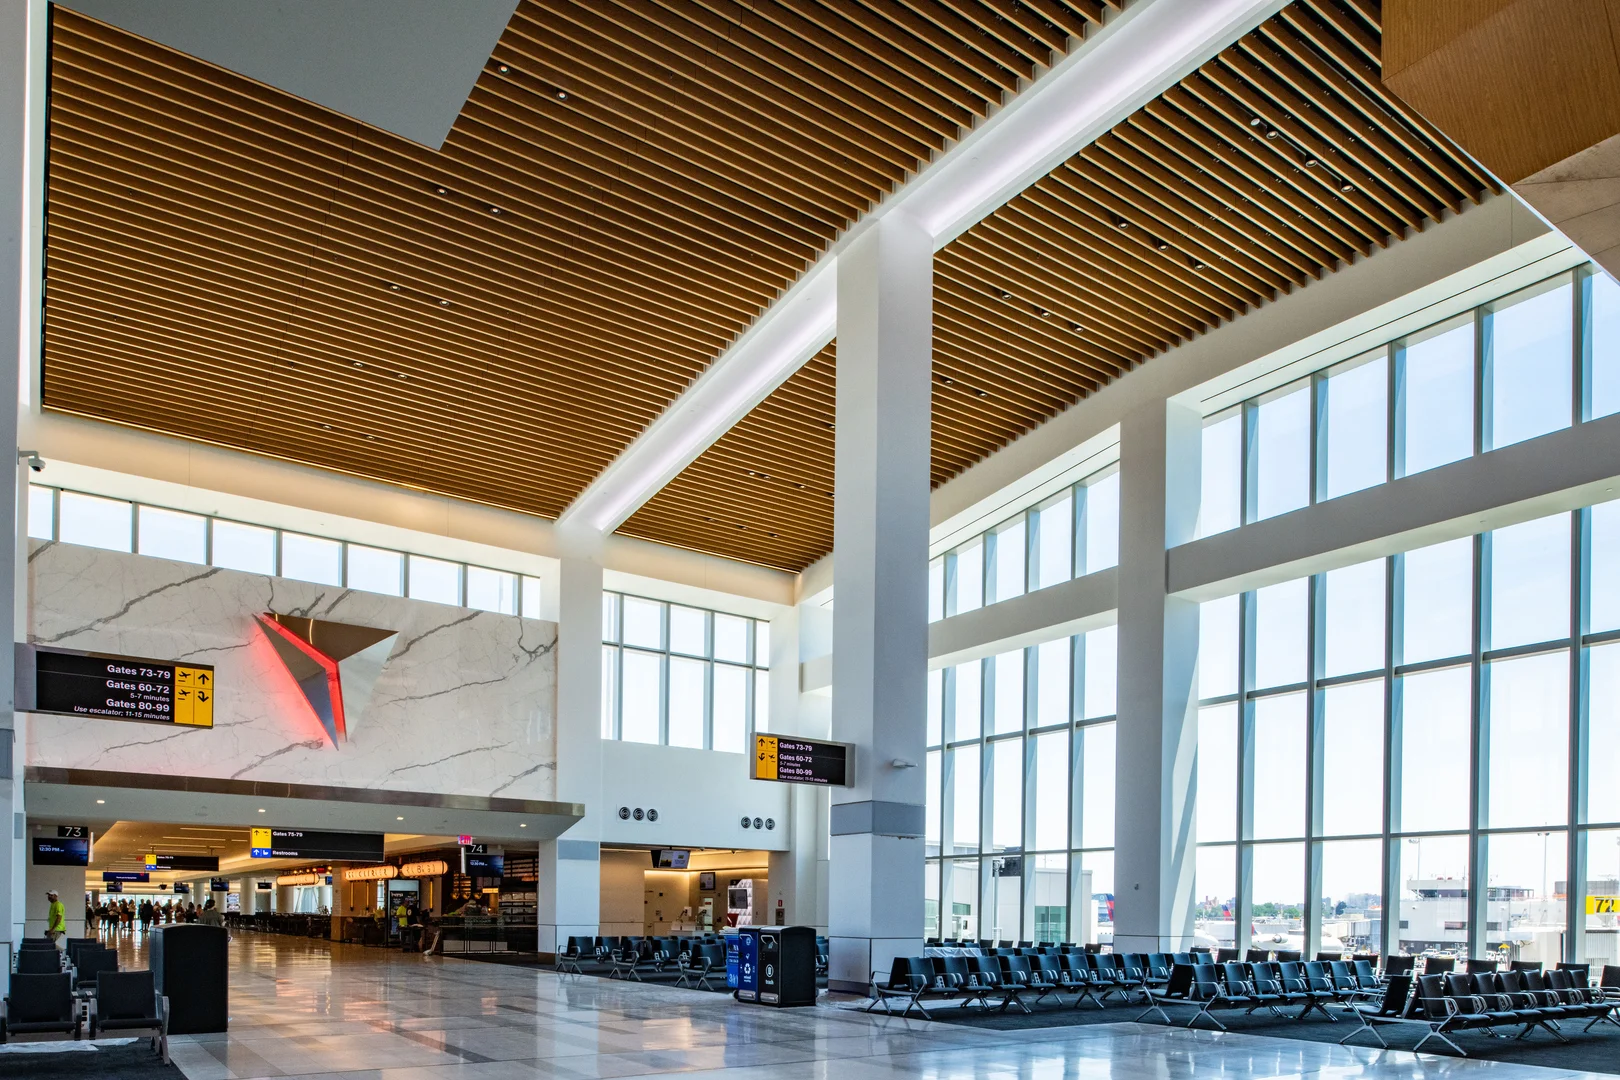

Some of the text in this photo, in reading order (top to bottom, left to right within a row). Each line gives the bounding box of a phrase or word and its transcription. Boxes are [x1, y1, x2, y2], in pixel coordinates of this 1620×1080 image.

[107, 664, 171, 679] Gates 73-79
[106, 680, 170, 694] Gates 60-72
[106, 698, 170, 712] Gates 80-99
[143, 694, 170, 702] minutes
[74, 705, 88, 713] Use
[143, 712, 170, 720] minutes
[779, 742, 812, 752] Gates 73-79
[64, 826, 82, 837] 73
[471, 844, 483, 853] 74
[1594, 896, 1614, 913] 72
